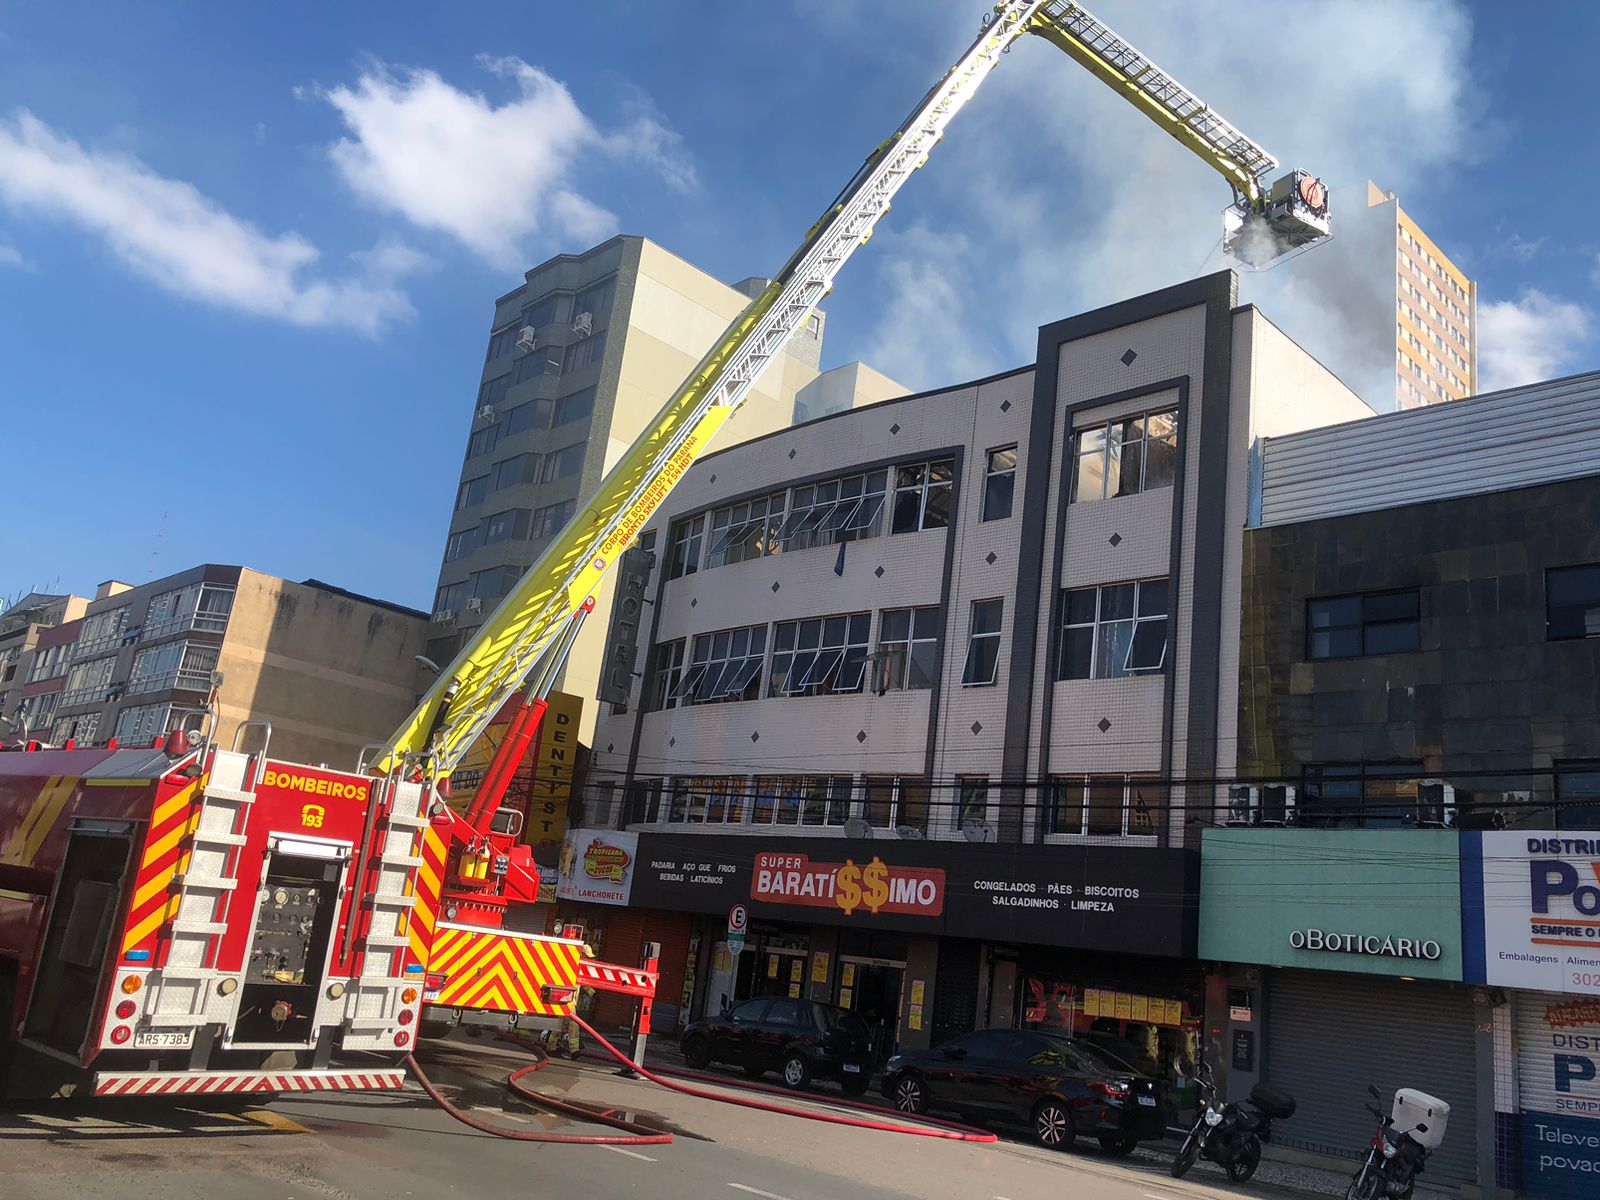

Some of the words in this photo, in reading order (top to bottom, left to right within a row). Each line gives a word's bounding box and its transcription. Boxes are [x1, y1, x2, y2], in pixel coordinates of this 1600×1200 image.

[602, 527, 624, 555] CORPO
[622, 514, 634, 529] DE
[631, 475, 666, 518] BOMBEIROS
[664, 463, 675, 477] DO
[619, 511, 646, 547] BRONTO
[643, 485, 668, 516] SKYLIFT
[264, 770, 367, 801] BOMBEIROS
[301, 813, 323, 828] 193
[651, 861, 676, 870] PADARIA
[718, 864, 737, 873] FRIOS
[760, 856, 802, 869] SUPER
[660, 872, 685, 882] BEBIDAS
[578, 889, 624, 900] LANCHONETE
[973, 880, 1036, 893] CONGELADOS
[1047, 883, 1073, 895] PÃES
[1084, 886, 1140, 899] BISCOITOS
[992, 896, 1059, 909] SALGADINHOS
[1071, 900, 1115, 912] LIMPEZA
[735, 909, 743, 924] E
[1531, 925, 1583, 938] SEMPRE
[1585, 927, 1596, 938] O
[1498, 951, 1559, 965] Embalagens
[1572, 972, 1600, 987] 302
[1553, 1053, 1597, 1093] P
[1555, 1098, 1600, 1112] SEMP
